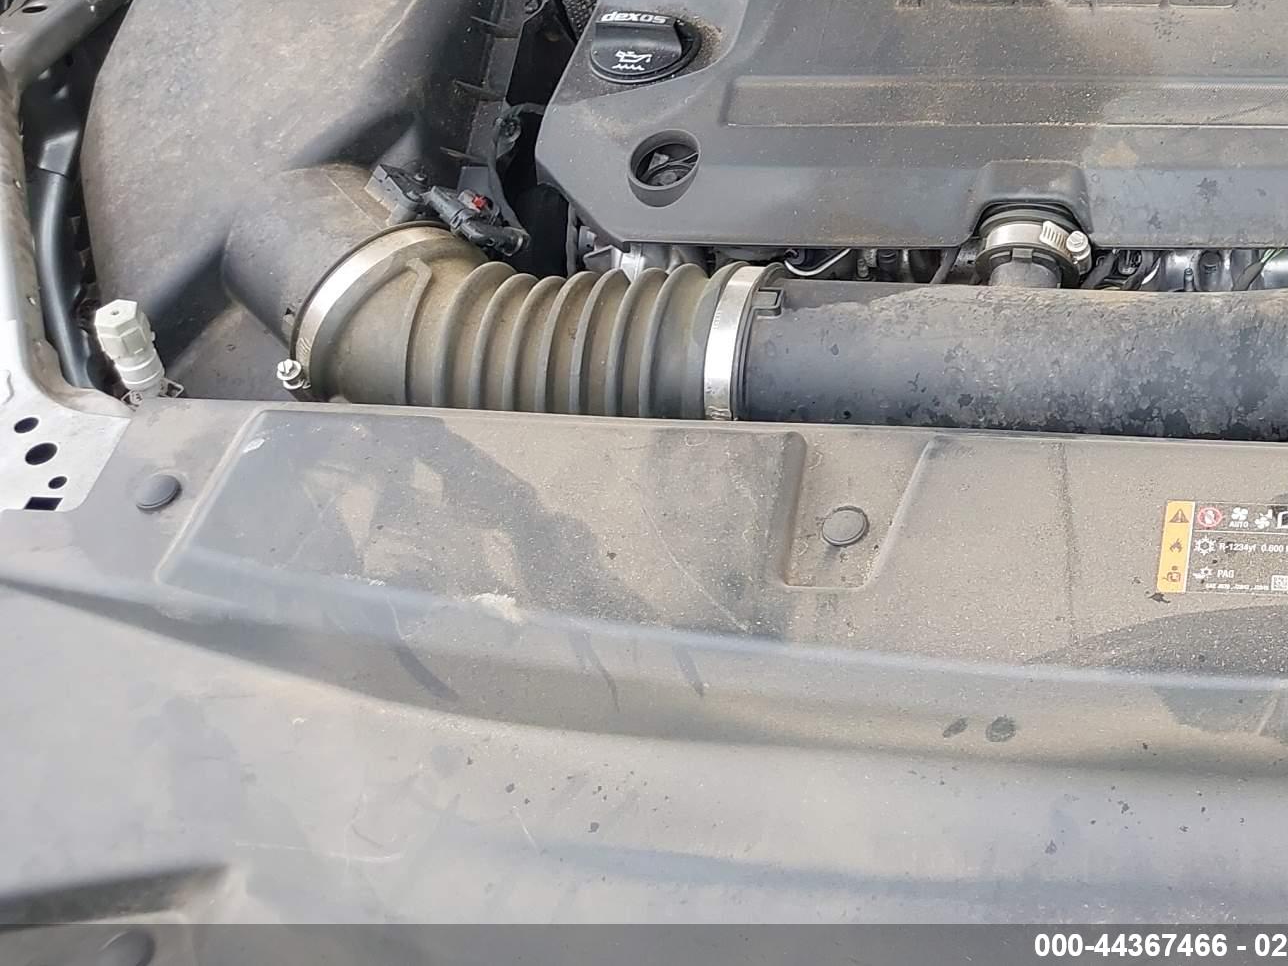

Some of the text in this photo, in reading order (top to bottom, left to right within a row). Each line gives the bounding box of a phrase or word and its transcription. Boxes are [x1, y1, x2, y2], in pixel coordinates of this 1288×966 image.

[600, 10, 671, 24] dexos
[1228, 520, 1249, 528] AUTO
[1218, 542, 1257, 553] R-1234yf
